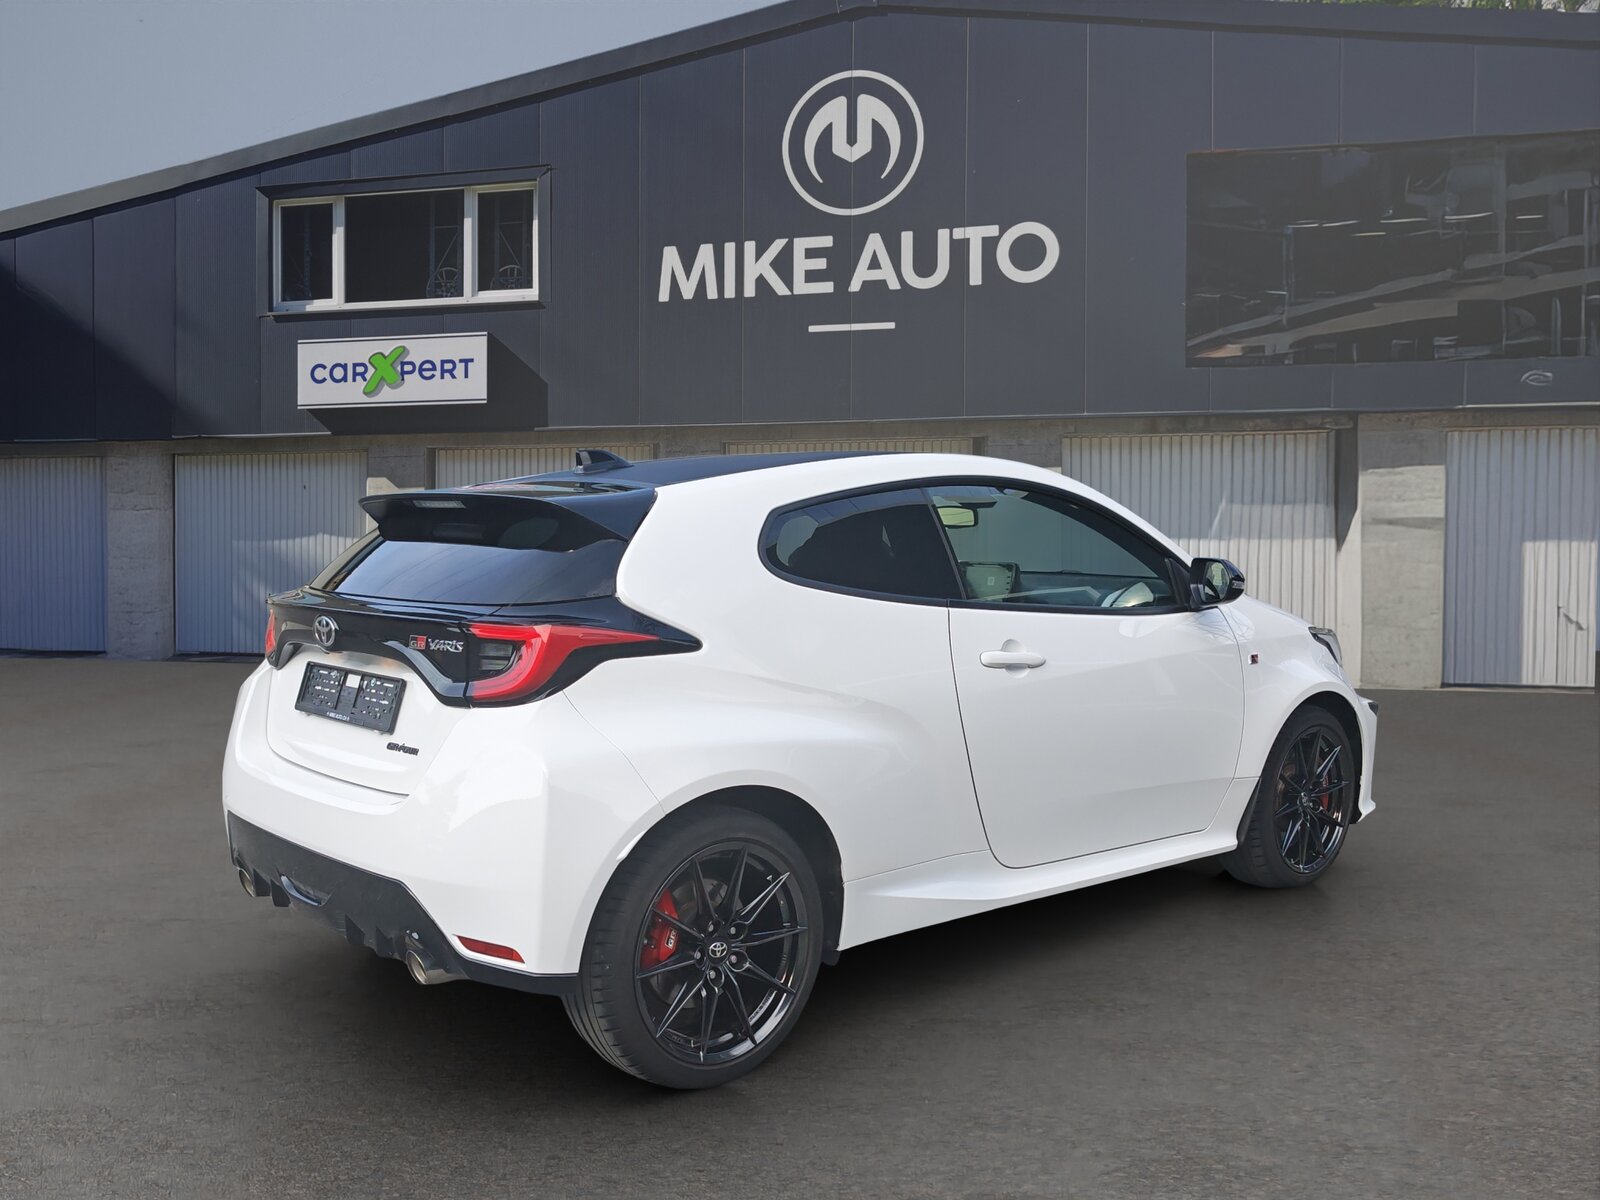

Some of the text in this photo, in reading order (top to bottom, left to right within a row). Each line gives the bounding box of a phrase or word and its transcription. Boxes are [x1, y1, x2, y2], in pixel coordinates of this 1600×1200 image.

[658, 221, 1060, 302] MIKE AUTO
[428, 638, 463, 652] YARIS
